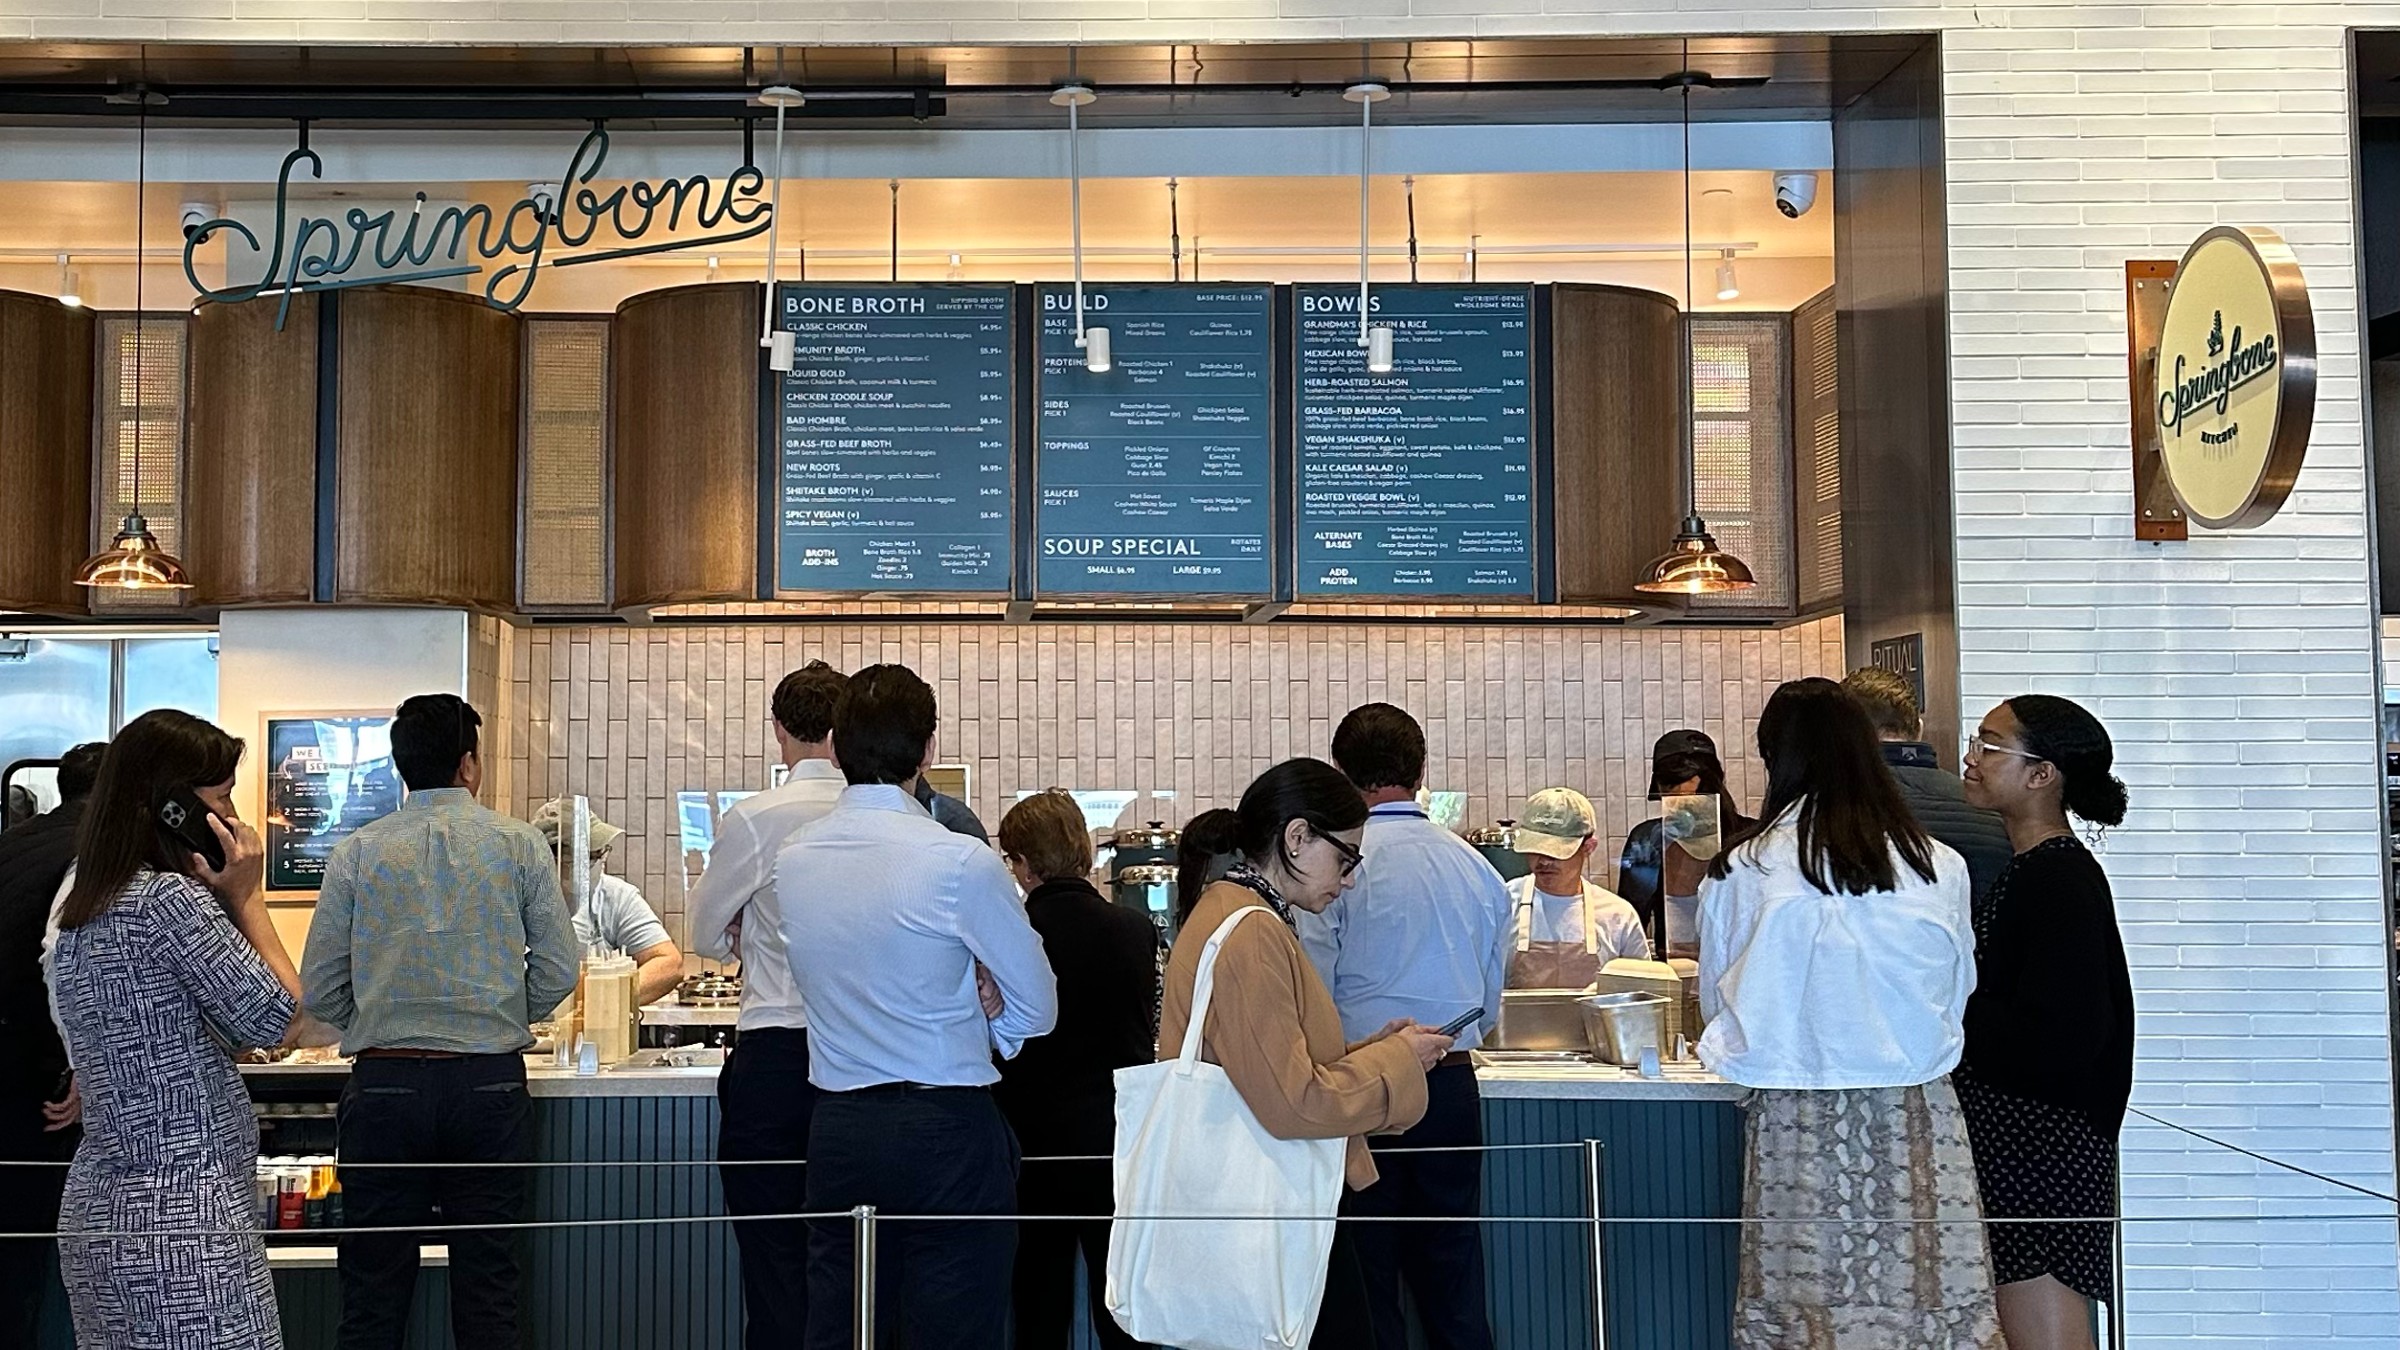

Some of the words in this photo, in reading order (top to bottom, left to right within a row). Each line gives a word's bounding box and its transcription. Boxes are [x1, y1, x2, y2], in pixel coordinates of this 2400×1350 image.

[183, 127, 773, 331] Springbone
[786, 297, 846, 313] BONE
[852, 297, 925, 313] BROTH
[1044, 294, 1108, 310] BULD
[786, 323, 824, 331] CLASSIC
[826, 323, 868, 331] CHICKEN
[834, 346, 866, 354] BROTH
[786, 370, 818, 378] LIQUID
[820, 370, 846, 378] GOLD
[1304, 378, 1370, 386] HERB-ROASTED
[1372, 378, 1409, 386] SALMON
[2159, 326, 2278, 438] Springbone
[786, 393, 828, 401] CHICKEN
[830, 393, 868, 401] ZOODLE
[868, 393, 894, 401] SOUP
[786, 416, 806, 424] BAD
[807, 416, 847, 424] HOMBRE
[786, 440, 837, 448] GRASS-FED
[838, 440, 860, 448] BEEF
[861, 440, 892, 448] BROTH
[1304, 436, 1335, 444] VEGAN
[1336, 436, 1392, 444] SHAKSHUKA
[1393, 436, 1406, 445] (v)
[1044, 442, 1090, 450] TOPPINGS
[1396, 465, 1408, 473] (v)
[862, 488, 874, 496] (v)
[1044, 490, 1079, 498] SAUCES
[1305, 493, 1345, 501] ROASTED
[1346, 493, 1378, 501] VEGGIE
[1380, 493, 1406, 501] BOWL
[1408, 494, 1420, 502] (v)
[848, 512, 860, 520] (v)
[1314, 532, 1362, 540] ALTERNATE
[1044, 539, 1105, 555] SOUP
[1111, 539, 1201, 555] SPECIAL
[1326, 541, 1352, 549] BASES
[806, 549, 836, 557] BROTH
[802, 558, 840, 566] ADD-INS
[1087, 566, 1115, 574] SMALL
[1172, 566, 1202, 574] LARGE
[1328, 568, 1348, 576] ADD
[1320, 577, 1358, 585] PROTEIN
[1873, 643, 1917, 674] RITUAL
[296, 749, 313, 758] WE
[284, 808, 290, 816] 2
[284, 842, 290, 850] 4
